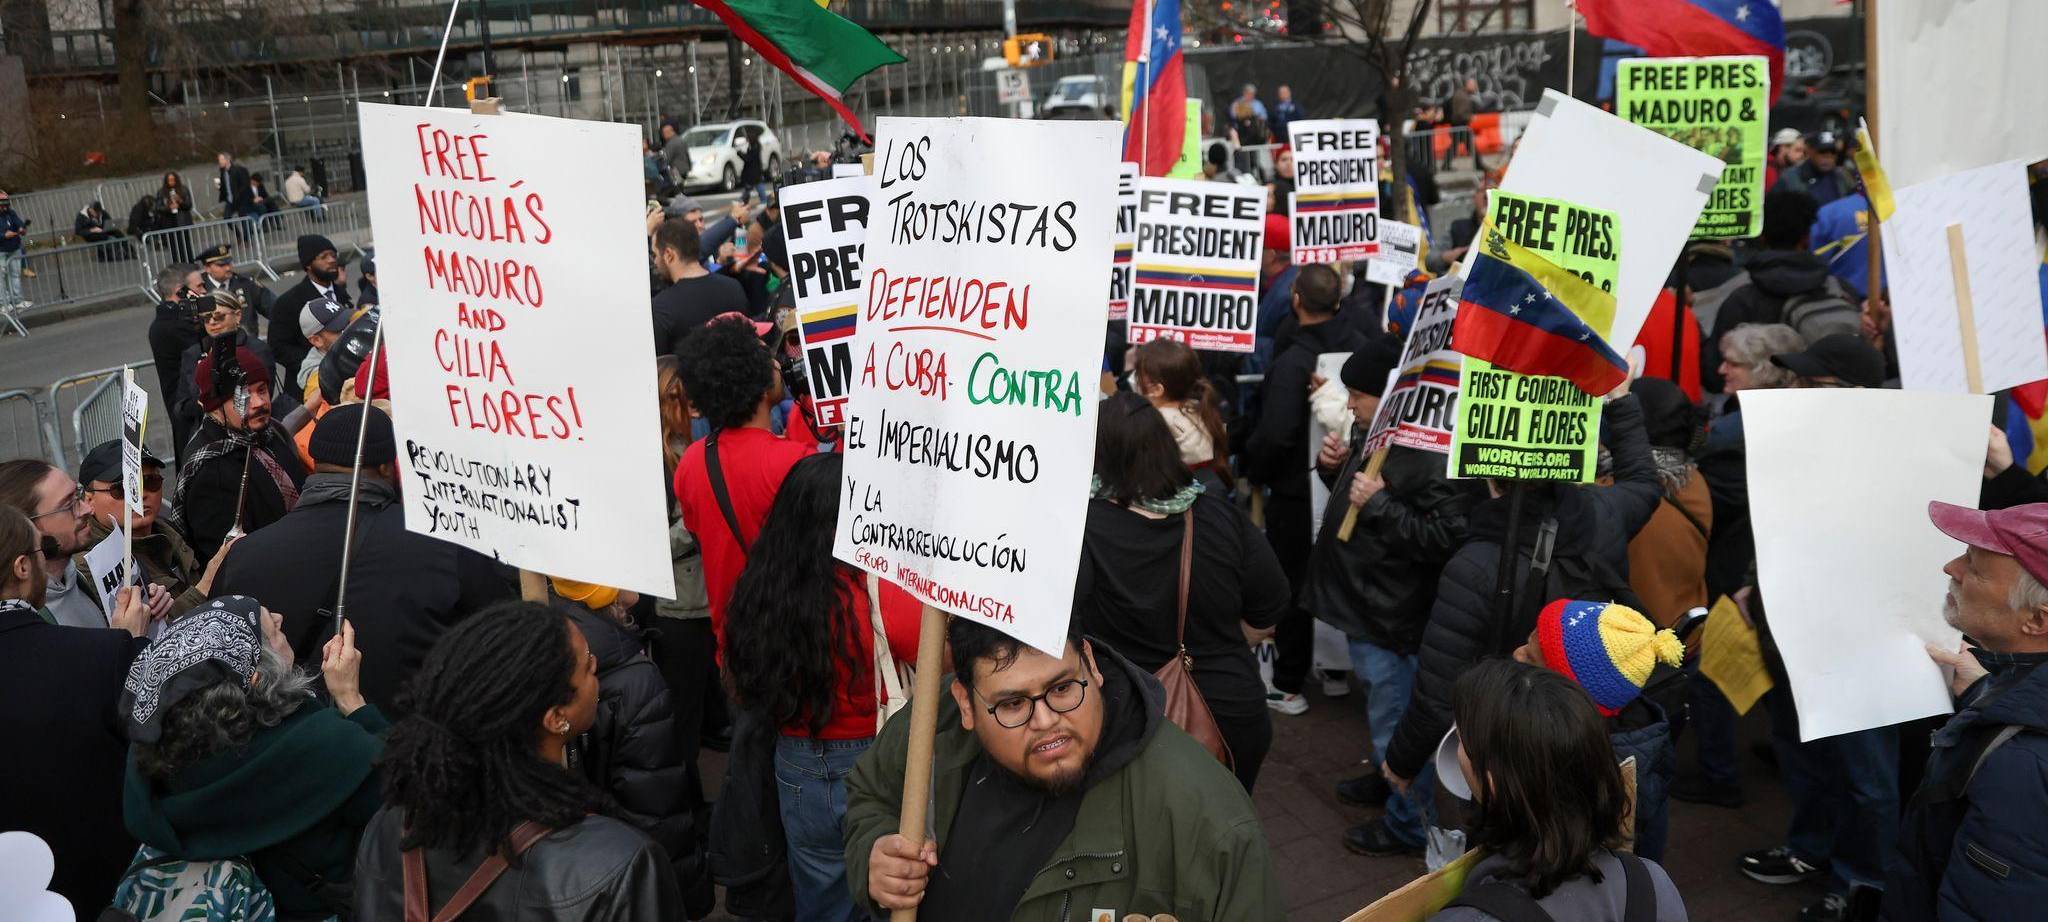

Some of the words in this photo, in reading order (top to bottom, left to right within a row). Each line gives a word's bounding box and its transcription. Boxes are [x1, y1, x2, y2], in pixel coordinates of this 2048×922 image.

[1630, 65, 1688, 91] FREE
[1696, 63, 1763, 90] PRES.
[1629, 98, 1731, 124] MADURO
[1739, 97, 1757, 122] &
[416, 123, 496, 182] FREE
[881, 135, 931, 189] LOS
[1294, 131, 1371, 151] FREE
[1298, 158, 1375, 186] PRESIDENT
[415, 180, 552, 245] NICOLÁS
[887, 190, 1077, 253] TROTSKISTAS
[1140, 190, 1260, 220] FREE
[1495, 196, 1560, 251] FREE
[1137, 223, 1260, 260] PRESIDENT
[1563, 207, 1617, 261] PRES.
[424, 246, 543, 308] MADURO
[866, 268, 1030, 332] DEFIENDEN
[458, 301, 506, 333] AND
[1132, 288, 1254, 330] MADURO
[434, 329, 515, 386] CILIA
[862, 342, 876, 388] A
[967, 351, 1083, 417] CONTRA
[1468, 371, 1512, 400] FIRST
[446, 385, 585, 442] FLORES!
[1467, 403, 1520, 442] CILIA
[1527, 409, 1588, 446] FLORES
[406, 438, 552, 497] REVOLUTIONARY
[849, 415, 866, 449] EL
[878, 408, 1039, 484] IMPERIALISMO
[1465, 463, 1516, 478] WORKERS
[1549, 468, 1579, 480] PARTY
[416, 470, 580, 532] INTERNATIONALIST
[424, 501, 480, 540] YOUTH
[847, 475, 856, 511] Y
[864, 483, 882, 513] LA
[851, 514, 1026, 573] CONTRARREVOLUCIÓN
[854, 547, 888, 573] GRUPO
[896, 563, 1015, 624] INTERNACIONALISTA
